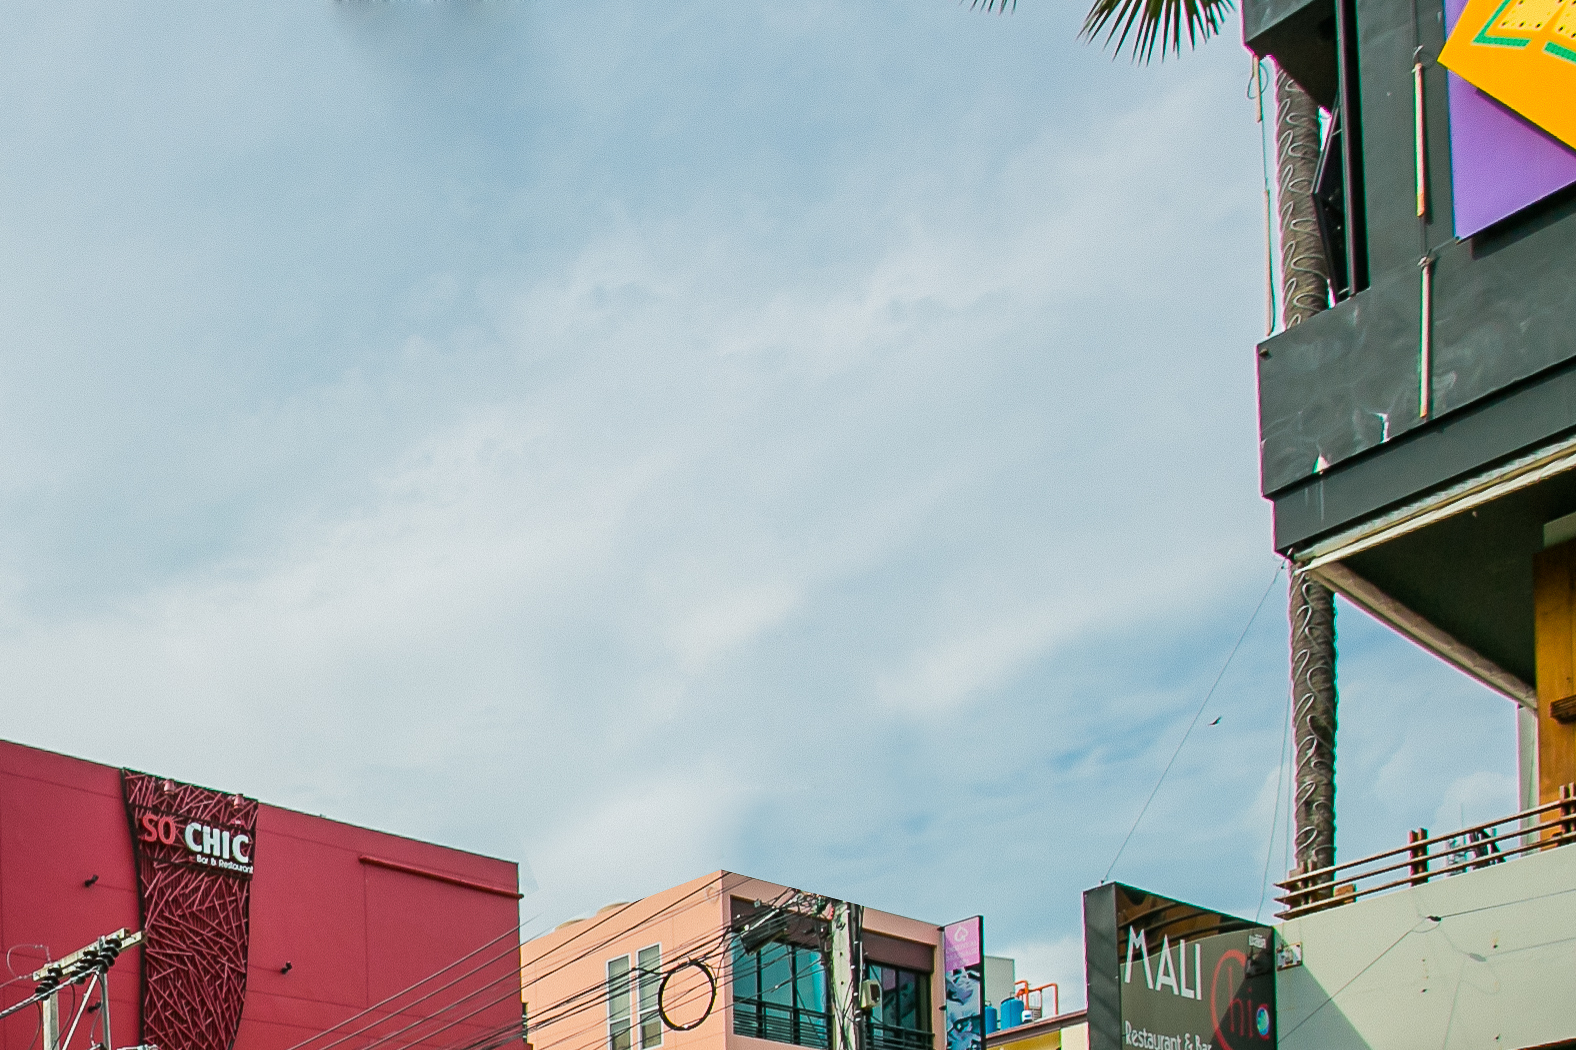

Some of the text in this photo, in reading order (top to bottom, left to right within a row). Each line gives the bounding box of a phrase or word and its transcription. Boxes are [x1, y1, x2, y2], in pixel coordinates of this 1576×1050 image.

[142, 813, 249, 863] SO CHIC
[196, 854, 208, 865] Bar
[218, 859, 254, 874] Restaurant
[1124, 925, 1203, 1000] MALI
